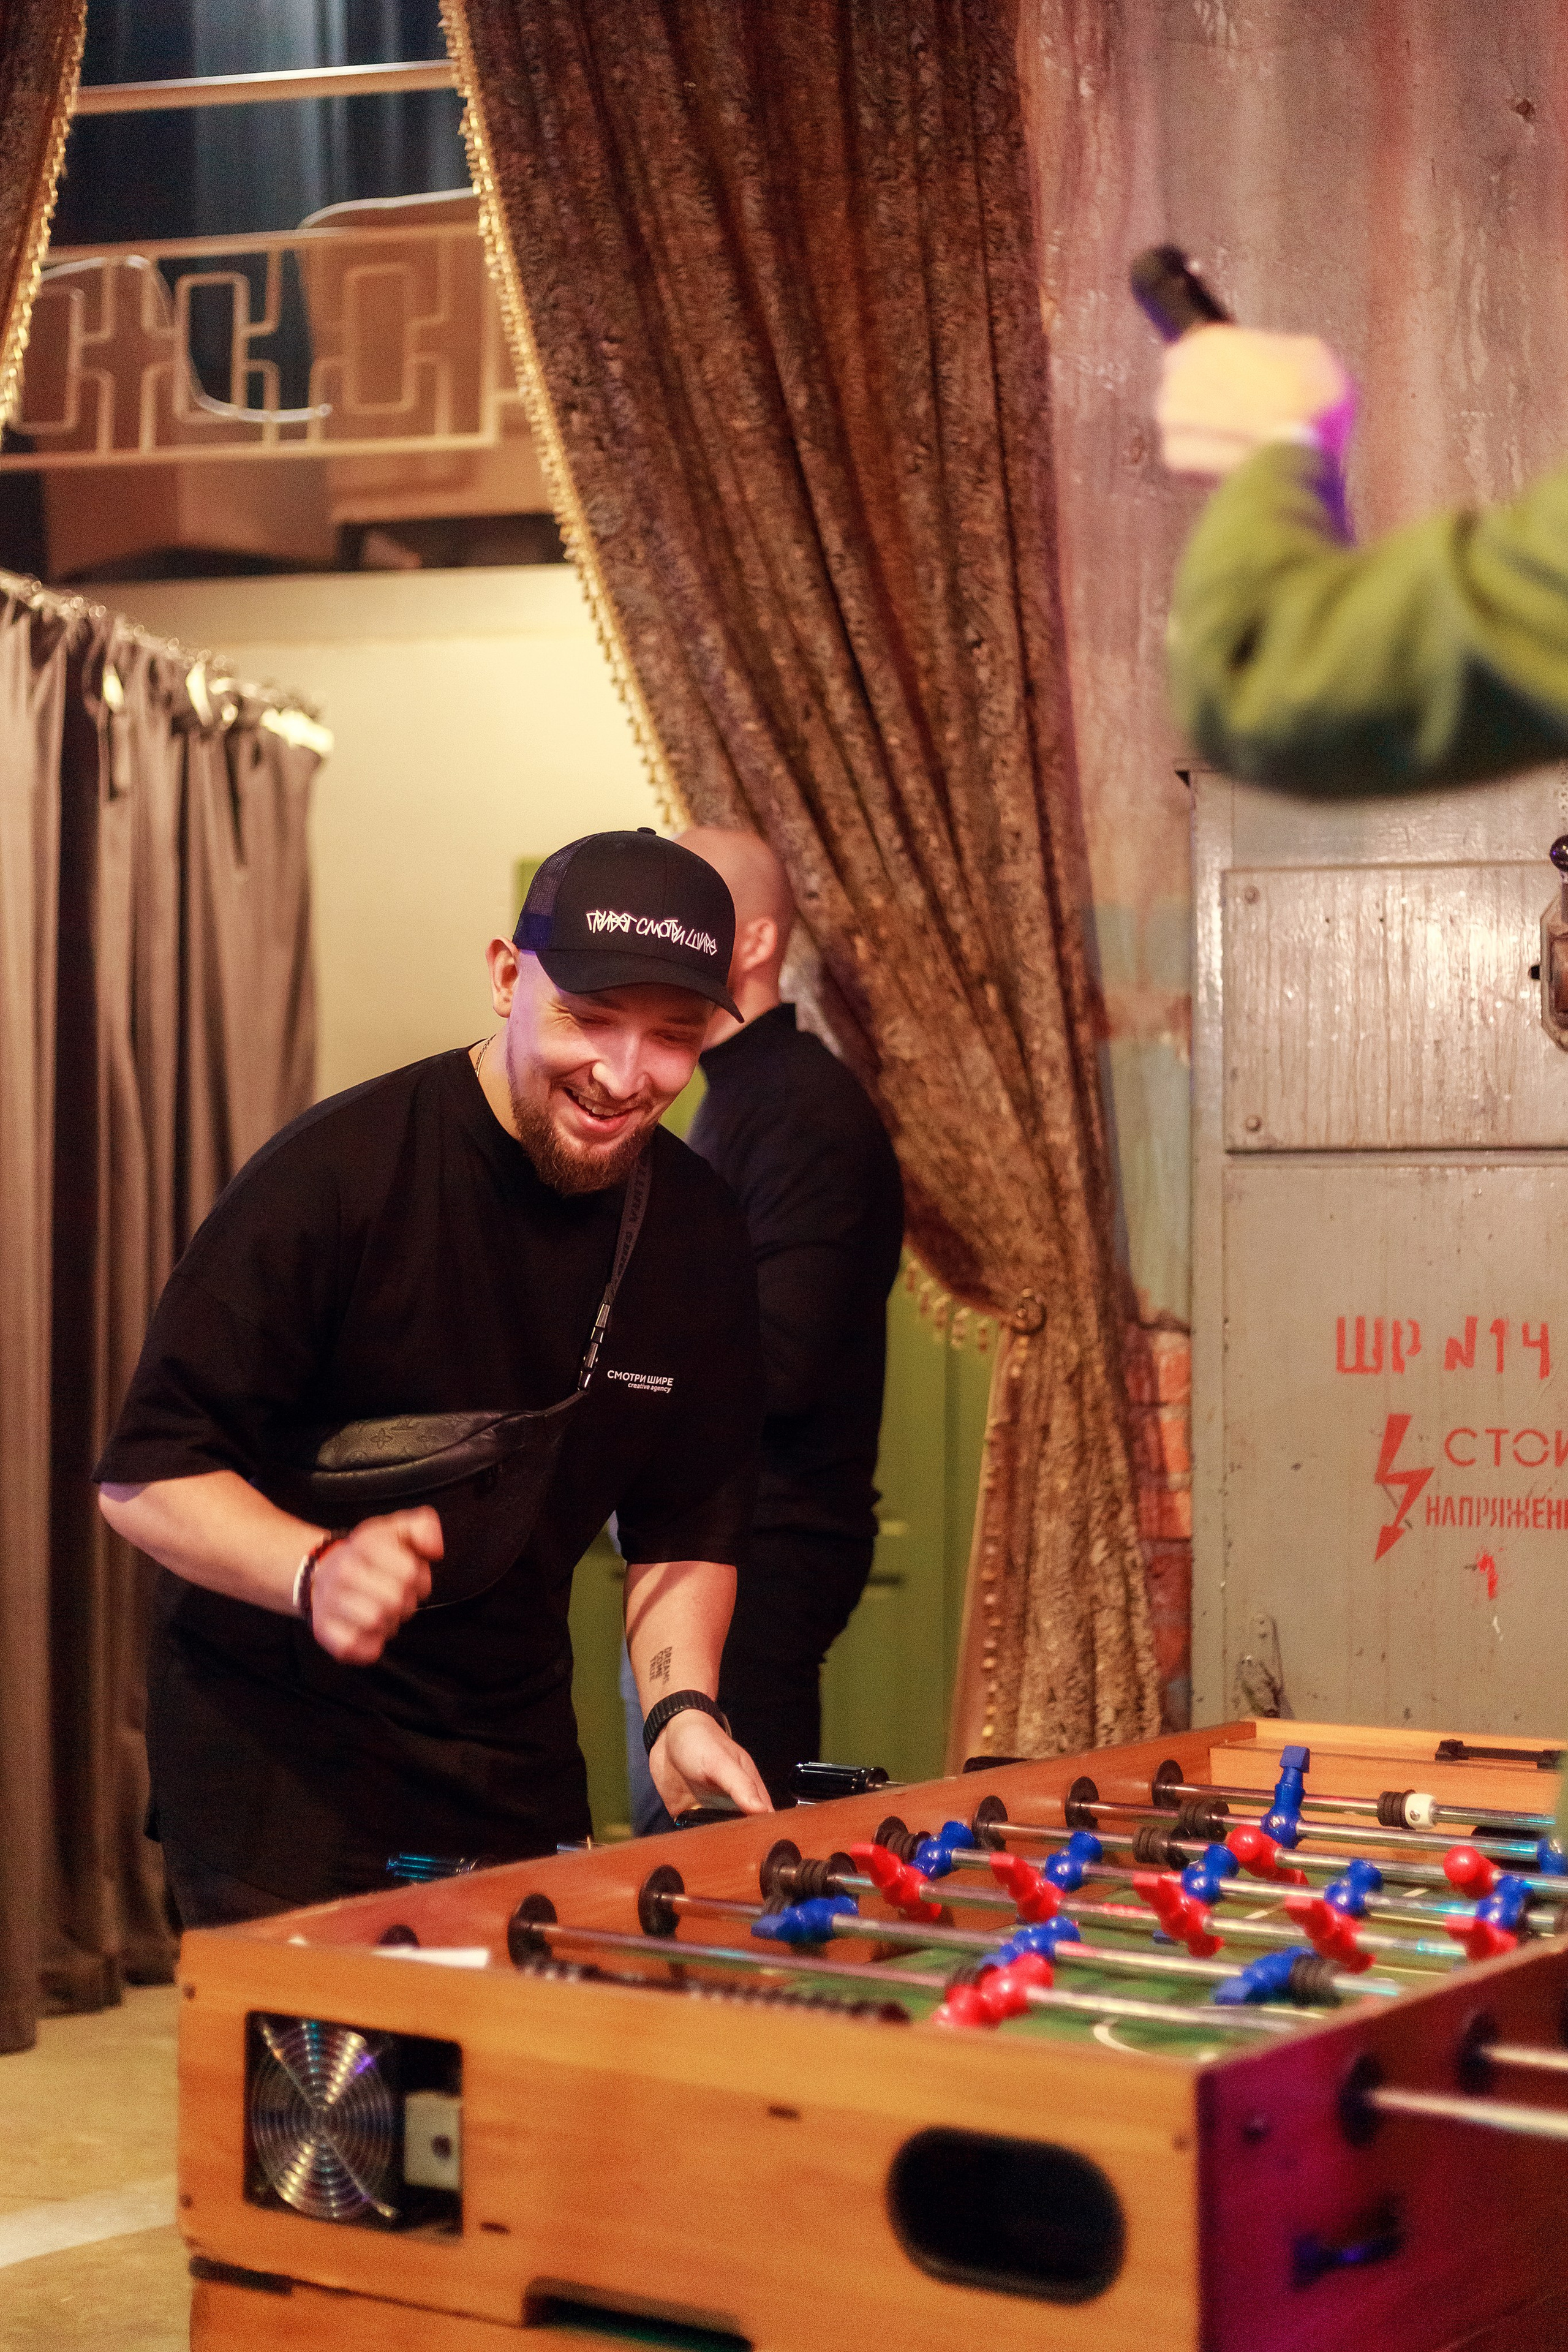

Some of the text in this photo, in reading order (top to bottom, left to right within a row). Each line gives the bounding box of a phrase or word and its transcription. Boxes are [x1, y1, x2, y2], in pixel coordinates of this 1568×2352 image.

[636, 918, 686, 945] СМОТРИ
[606, 1370, 674, 1386] СМОТРИ ШИРЕ
[650, 1385, 671, 1393] agency
